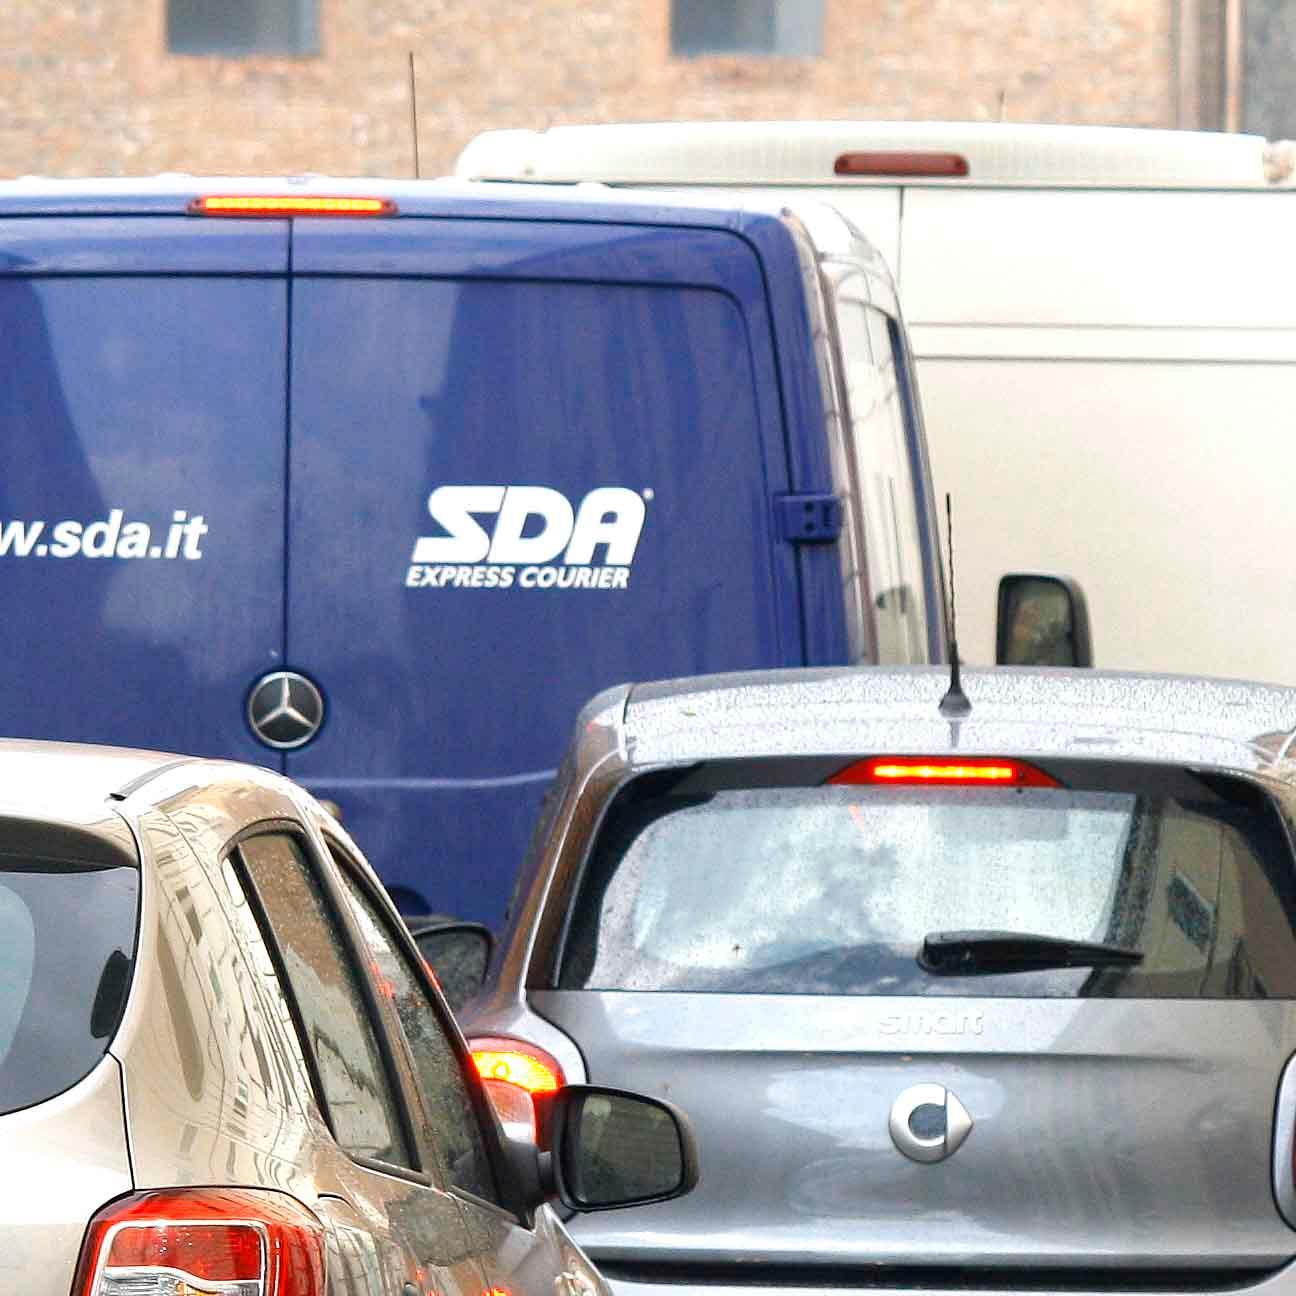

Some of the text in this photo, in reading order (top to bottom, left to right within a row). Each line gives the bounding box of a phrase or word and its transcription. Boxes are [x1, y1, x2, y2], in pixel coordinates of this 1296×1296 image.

[412, 485, 647, 565] SDA
[406, 564, 631, 590] EXPRESS COURIER
